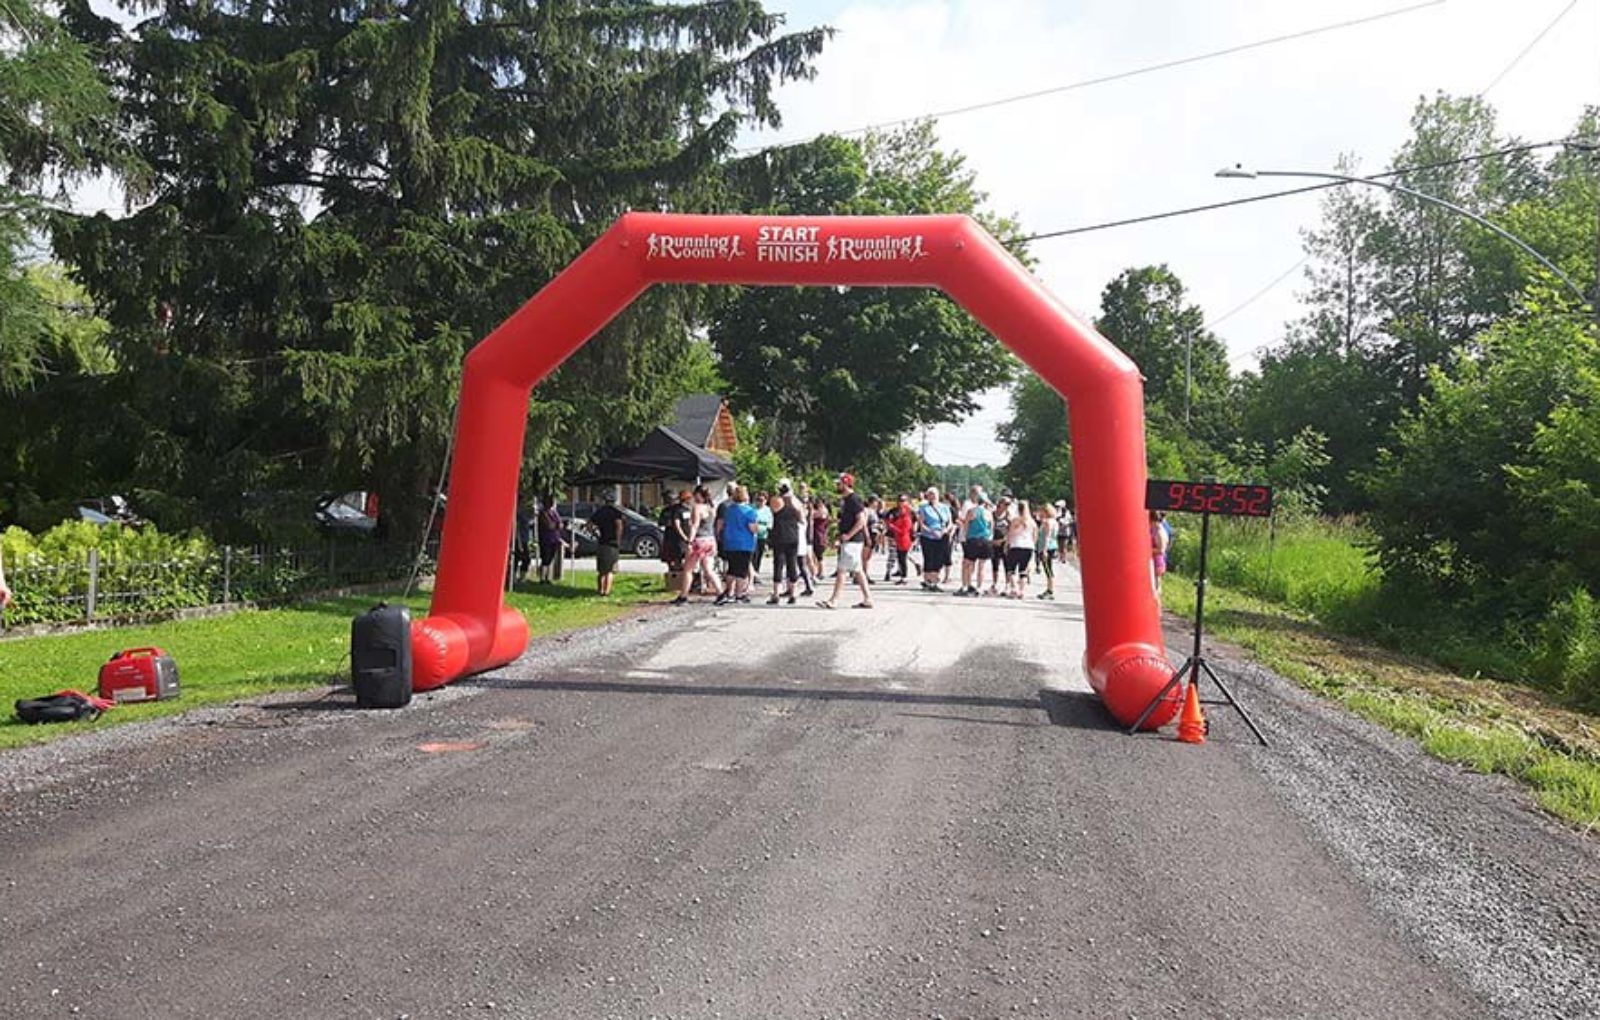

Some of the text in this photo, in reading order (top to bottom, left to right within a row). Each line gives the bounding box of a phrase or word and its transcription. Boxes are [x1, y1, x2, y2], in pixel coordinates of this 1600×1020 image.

[758, 225, 820, 241] START
[660, 233, 729, 259] Running
[757, 245, 819, 262] FINISH
[840, 235, 912, 260] Running
[1169, 483, 1268, 514] 9:52:52
